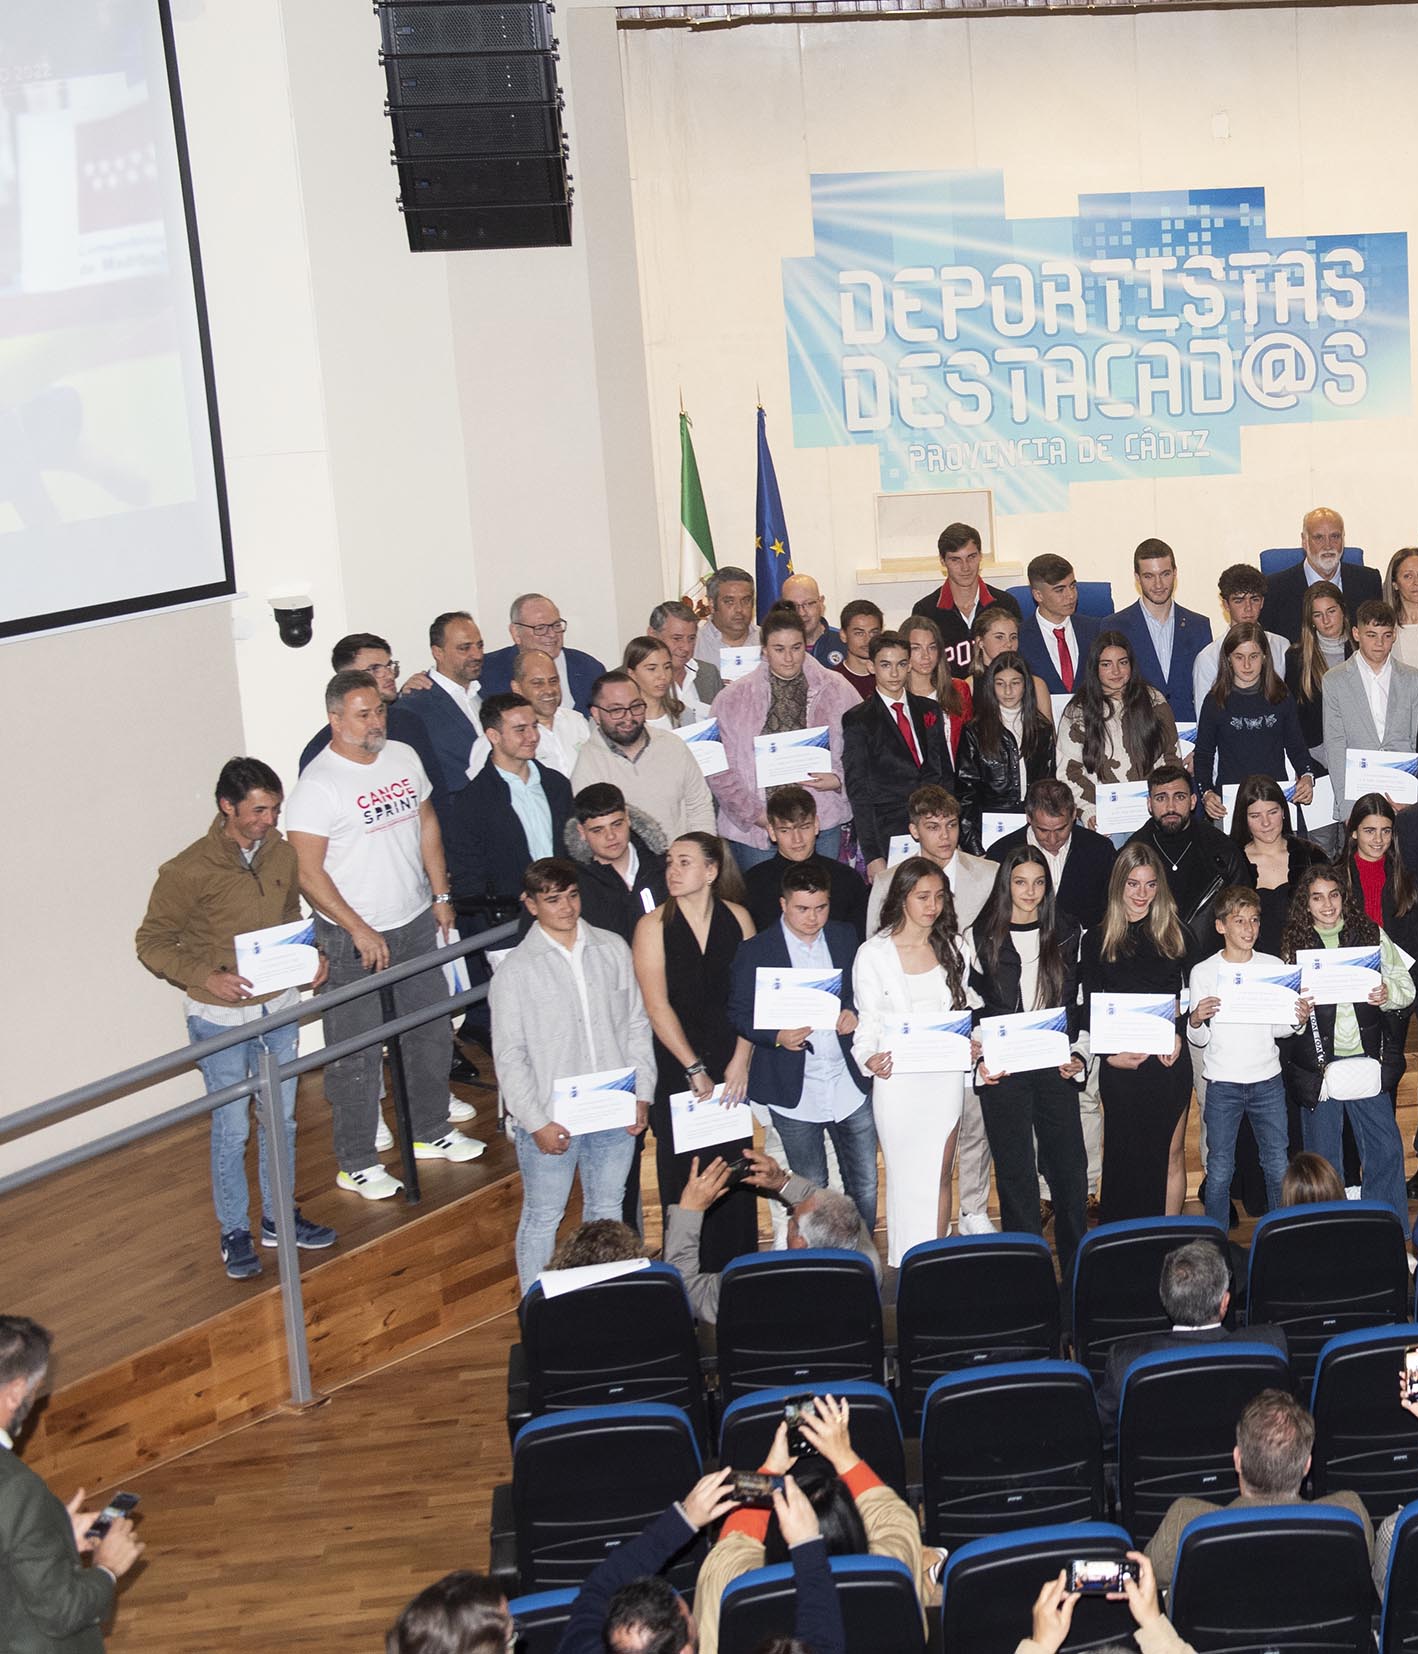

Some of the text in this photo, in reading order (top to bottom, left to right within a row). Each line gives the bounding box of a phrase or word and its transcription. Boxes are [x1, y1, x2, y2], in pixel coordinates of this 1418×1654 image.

[837, 247, 1367, 345] DEPORTISTAS
[840, 331, 1368, 432] DESTACAD@S
[908, 426, 1212, 474] PROVINCIA DE CÁDIZ
[357, 779, 415, 809] CANOE
[364, 795, 418, 824] SPRINT
